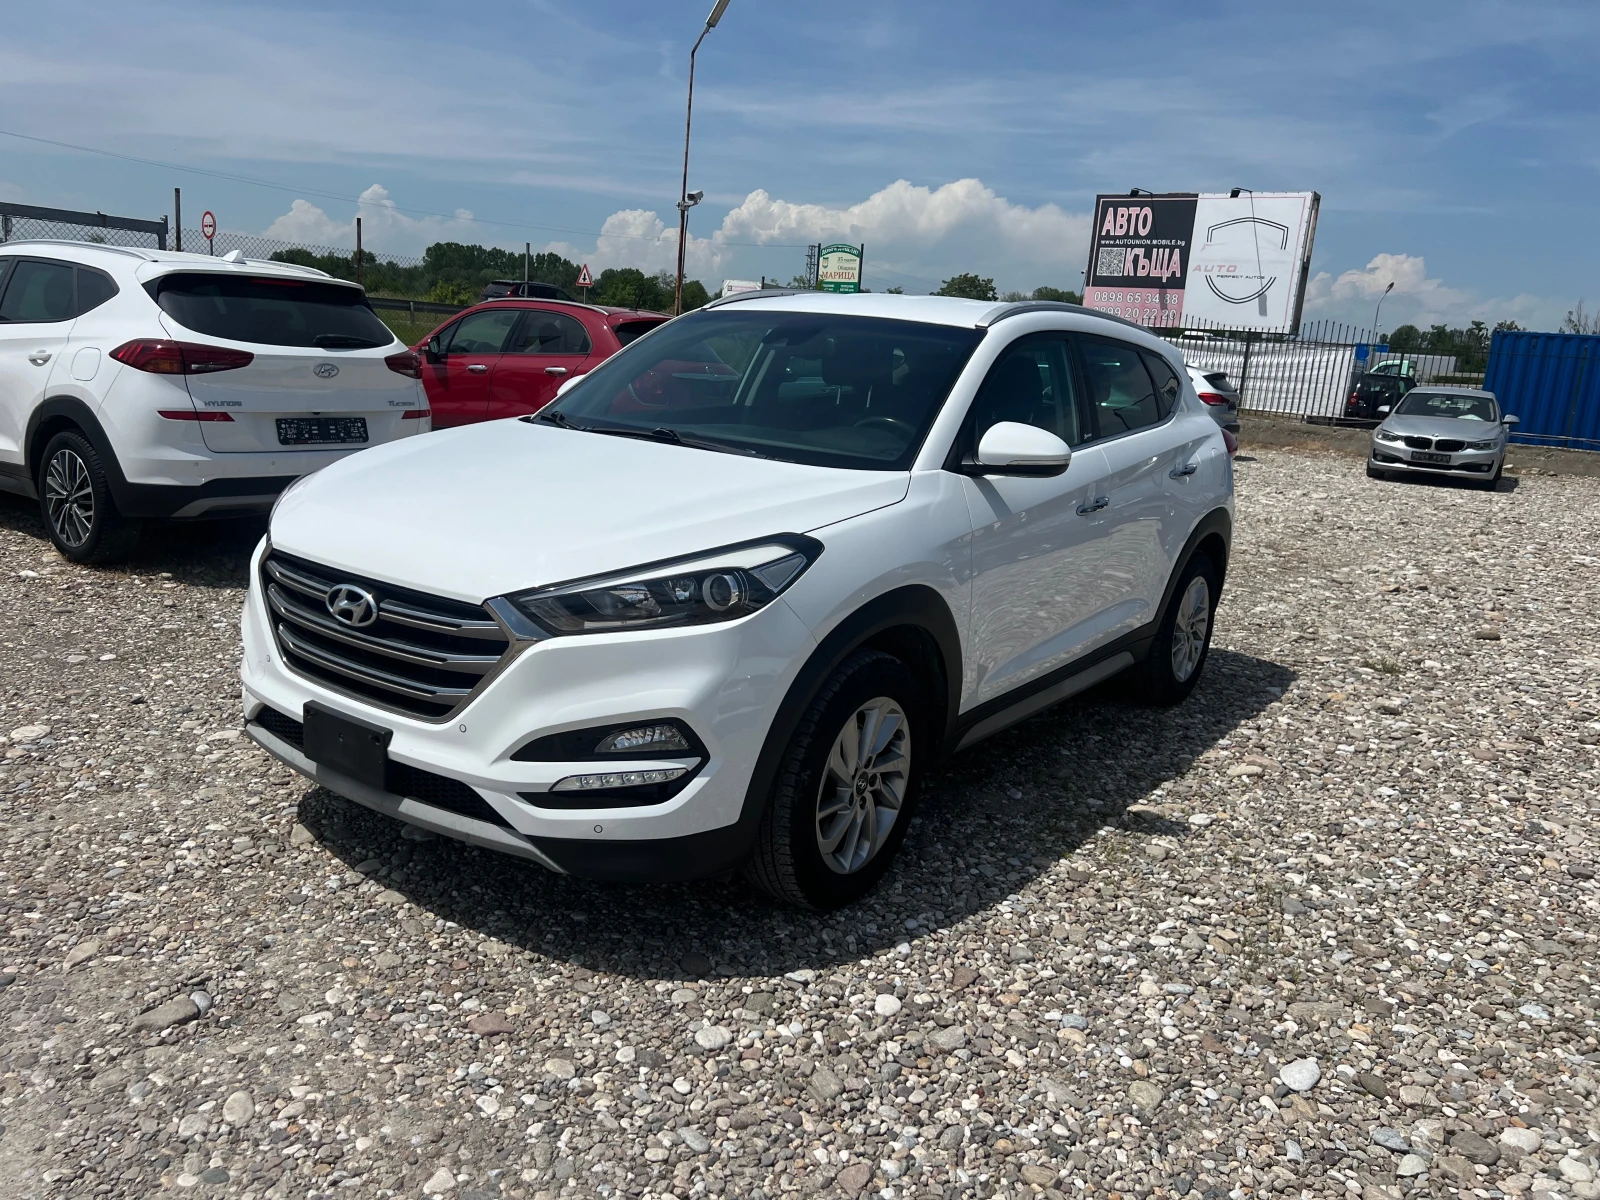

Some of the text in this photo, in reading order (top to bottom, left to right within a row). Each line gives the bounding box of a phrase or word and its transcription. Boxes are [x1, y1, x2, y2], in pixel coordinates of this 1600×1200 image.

[1101, 207, 1153, 236] АВТО
[1124, 248, 1180, 282] КЪЩА
[1192, 264, 1238, 273] AUTO
[822, 271, 855, 280] МАРИЦА
[1094, 291, 1179, 305] 0898 65 34 88
[1124, 307, 1139, 318] 20
[1143, 308, 1158, 319] 22
[1162, 309, 1177, 320] 20
